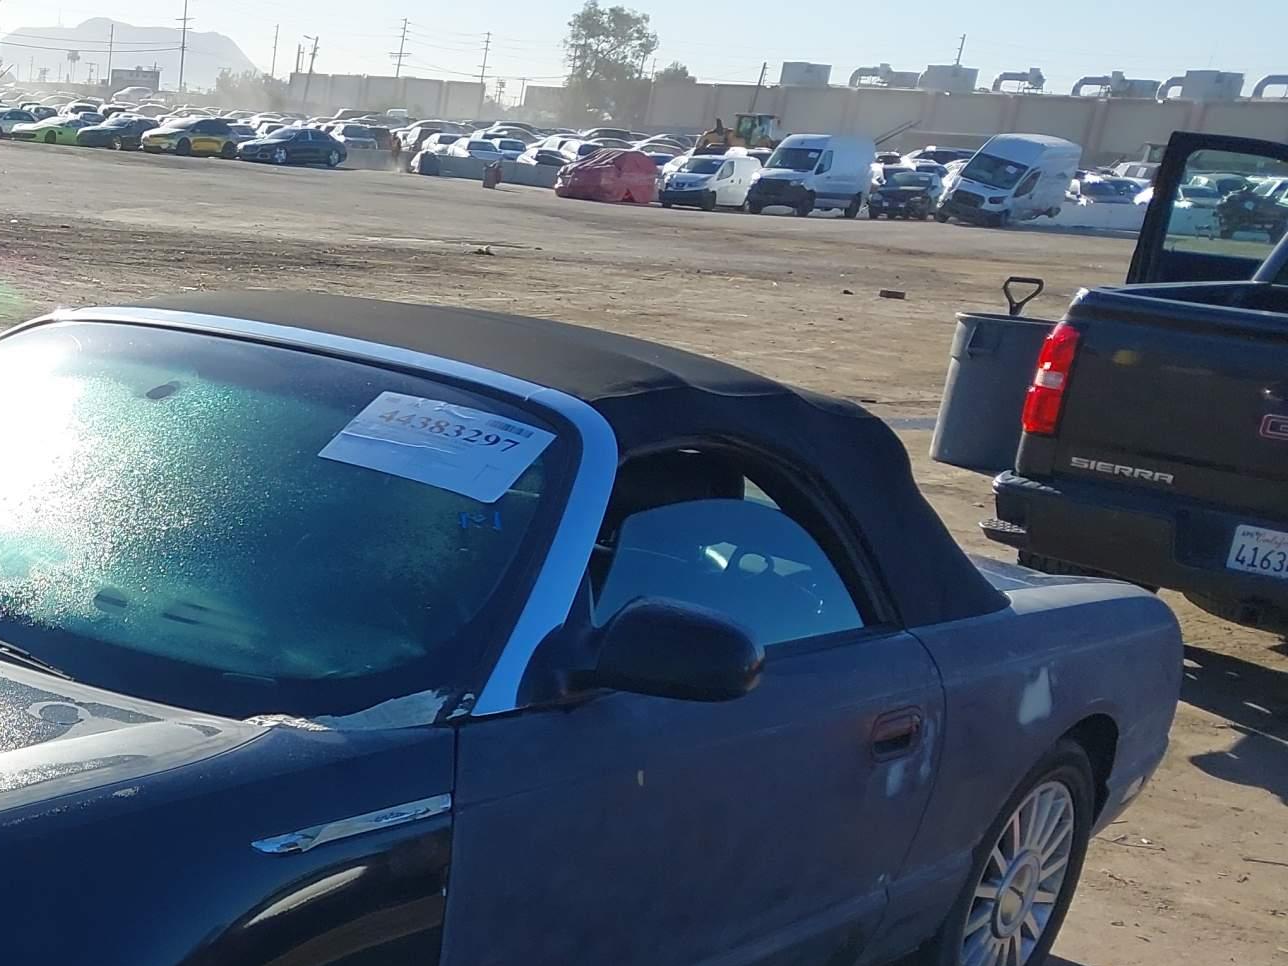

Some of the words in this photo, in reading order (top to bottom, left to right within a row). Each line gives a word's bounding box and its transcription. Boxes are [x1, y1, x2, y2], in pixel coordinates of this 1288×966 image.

[378, 409, 520, 453] 44383297
[1070, 456, 1174, 484] SIERRA
[1235, 544, 1288, 573] 4163
